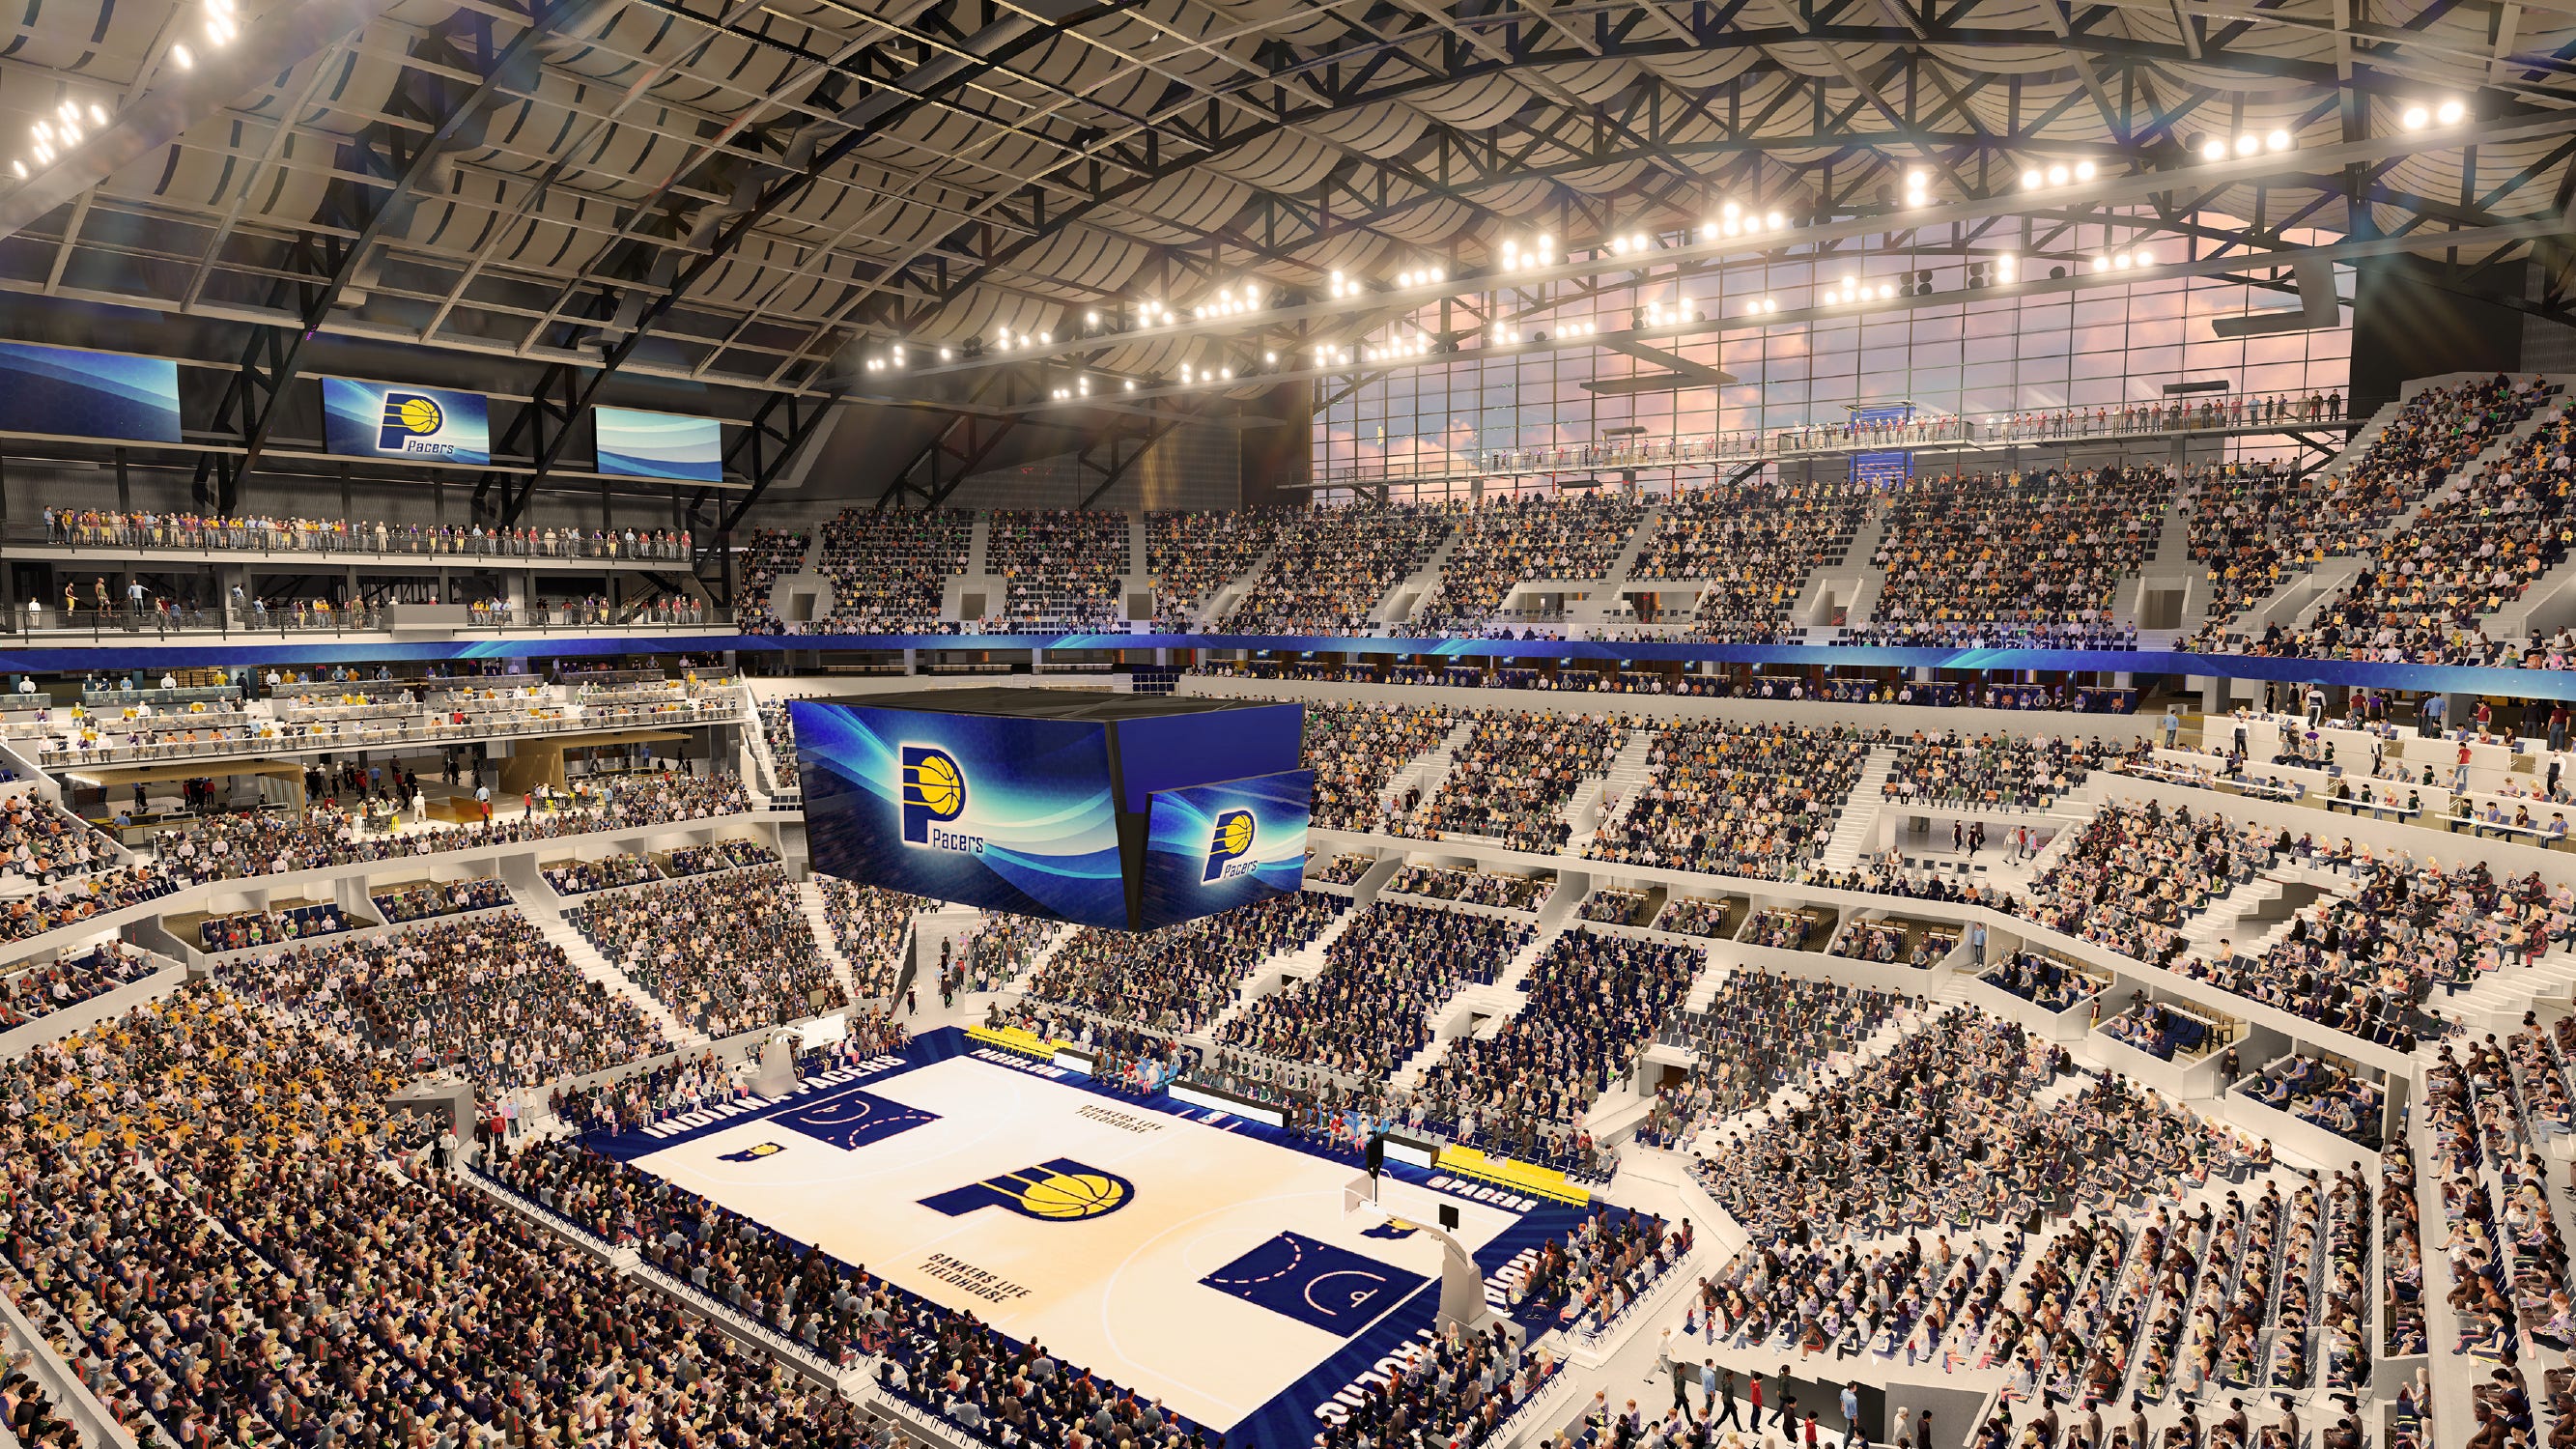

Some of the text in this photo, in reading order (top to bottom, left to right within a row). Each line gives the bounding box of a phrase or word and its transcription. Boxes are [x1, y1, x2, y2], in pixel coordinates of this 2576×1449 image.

[407, 440, 455, 455] Pacers
[933, 828, 983, 854] Pacers
[1223, 860, 1259, 878] Pacers
[1075, 1110, 1148, 1134] FIELDHOUSE
[1081, 1104, 1166, 1131] BANKERS LIFE
[1426, 1175, 1539, 1212] @PACERS
[918, 1262, 1010, 1304] FIELDHOUSE
[927, 1253, 1033, 1298] BANKERS LIFE
